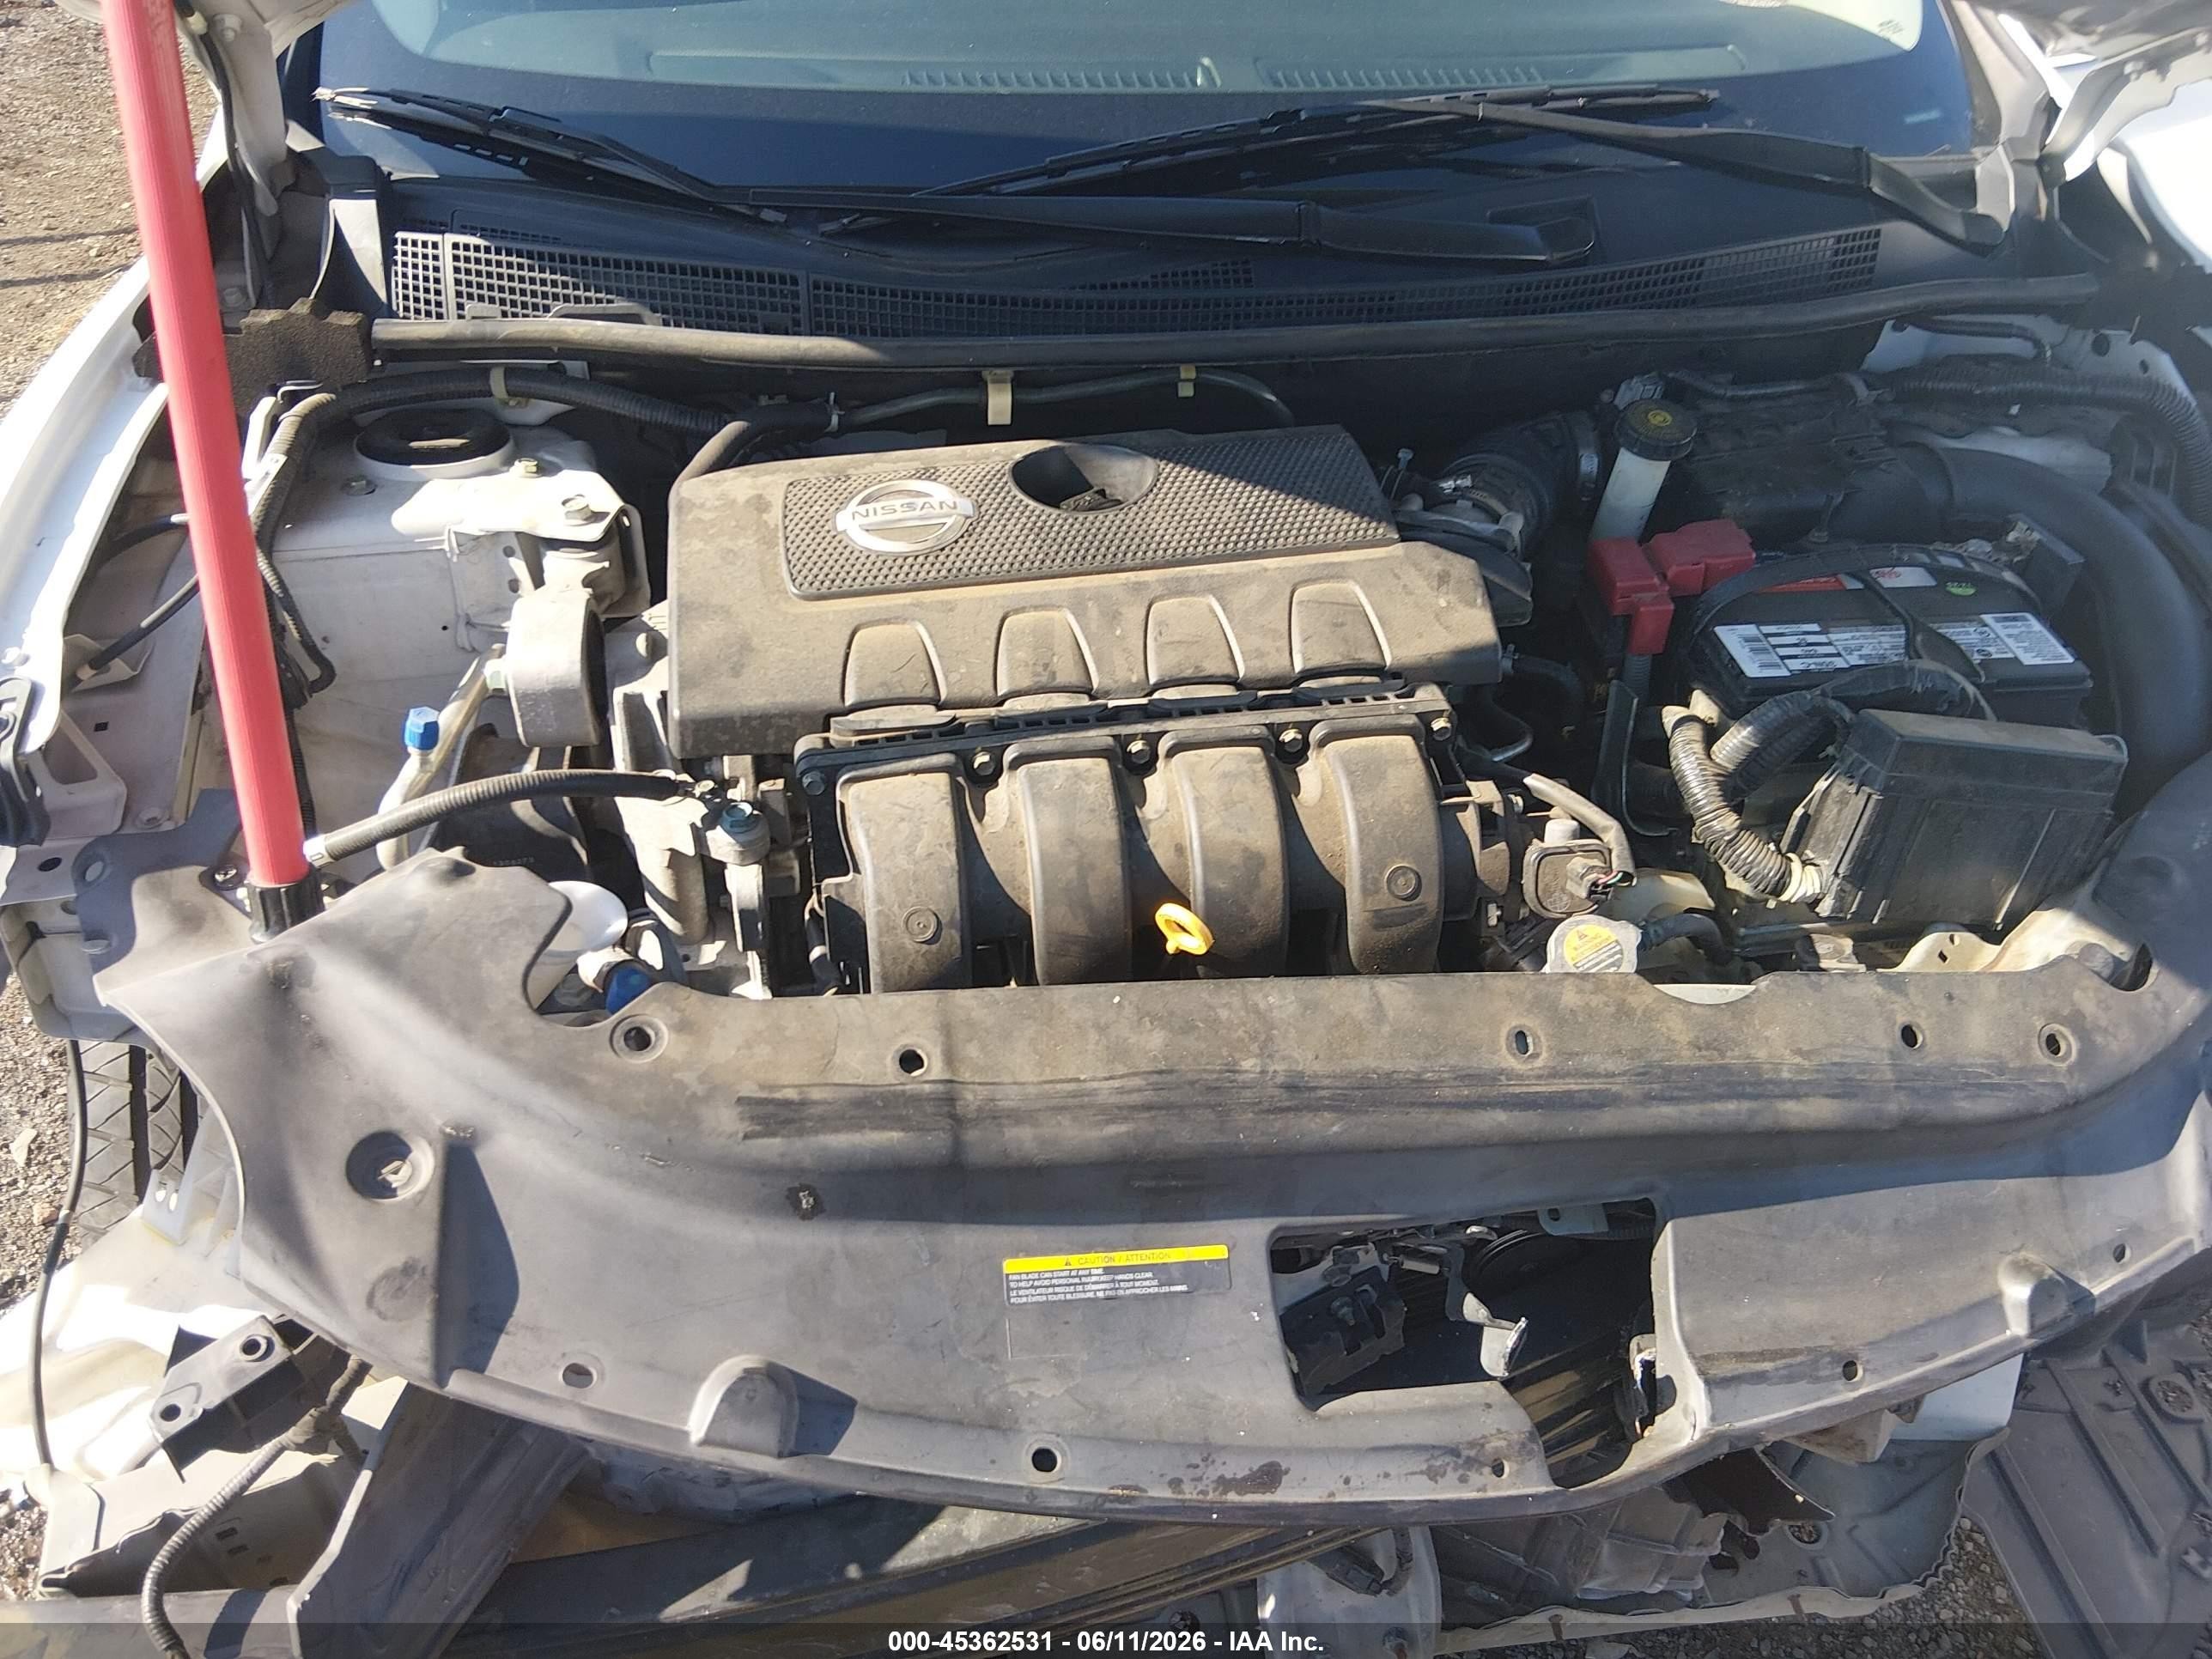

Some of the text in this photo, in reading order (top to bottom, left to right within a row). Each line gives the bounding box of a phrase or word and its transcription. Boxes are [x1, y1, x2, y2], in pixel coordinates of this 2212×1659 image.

[852, 501, 957, 520] NISSAN
[1078, 1255, 1116, 1266] CAUTION
[1126, 1251, 1171, 1263] ATTENTION
